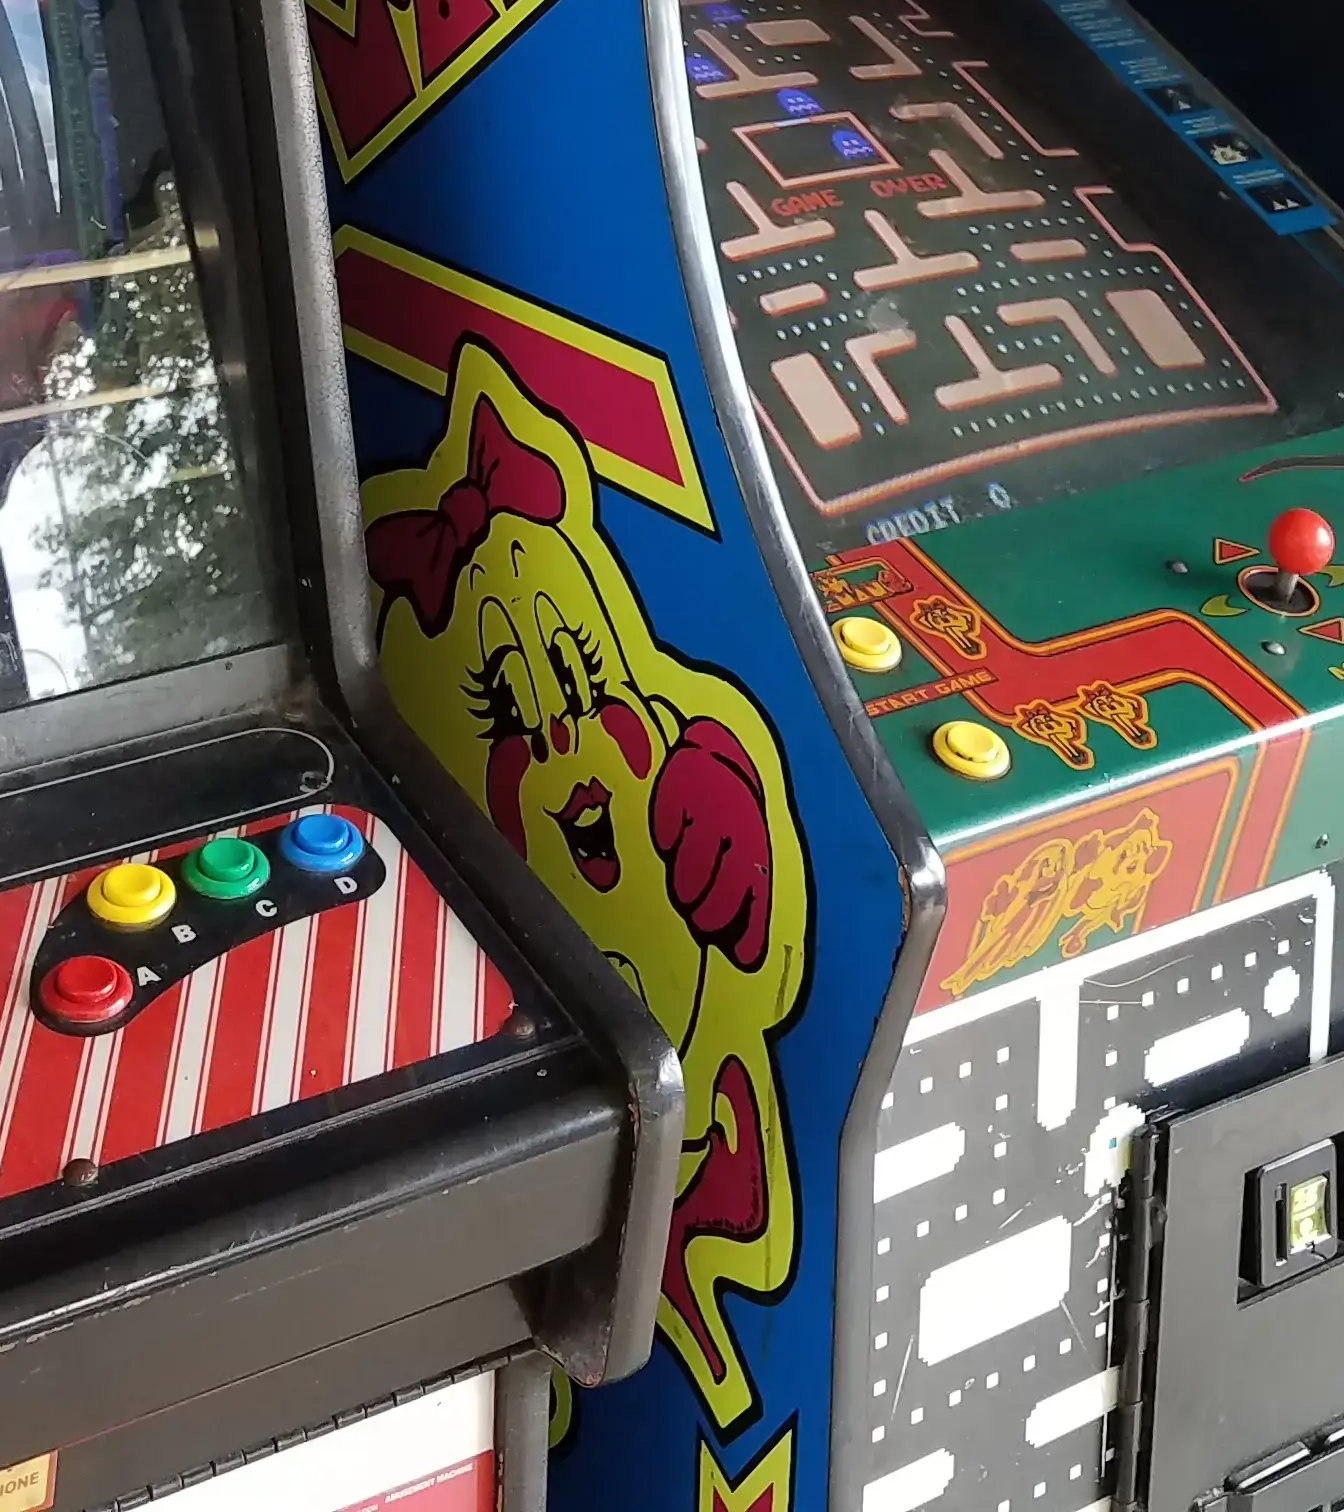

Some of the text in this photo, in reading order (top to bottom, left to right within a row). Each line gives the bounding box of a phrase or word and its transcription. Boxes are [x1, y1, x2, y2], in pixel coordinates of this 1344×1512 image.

[770, 172, 949, 217] GAME OVER
[864, 495, 961, 546] CREDIT
[865, 669, 993, 716] START GAME
[335, 876, 359, 896] D
[255, 898, 279, 919] C
[172, 923, 198, 944] B
[136, 965, 162, 987] A
[384, 1462, 474, 1504] AMUSEMENT MACHINE
